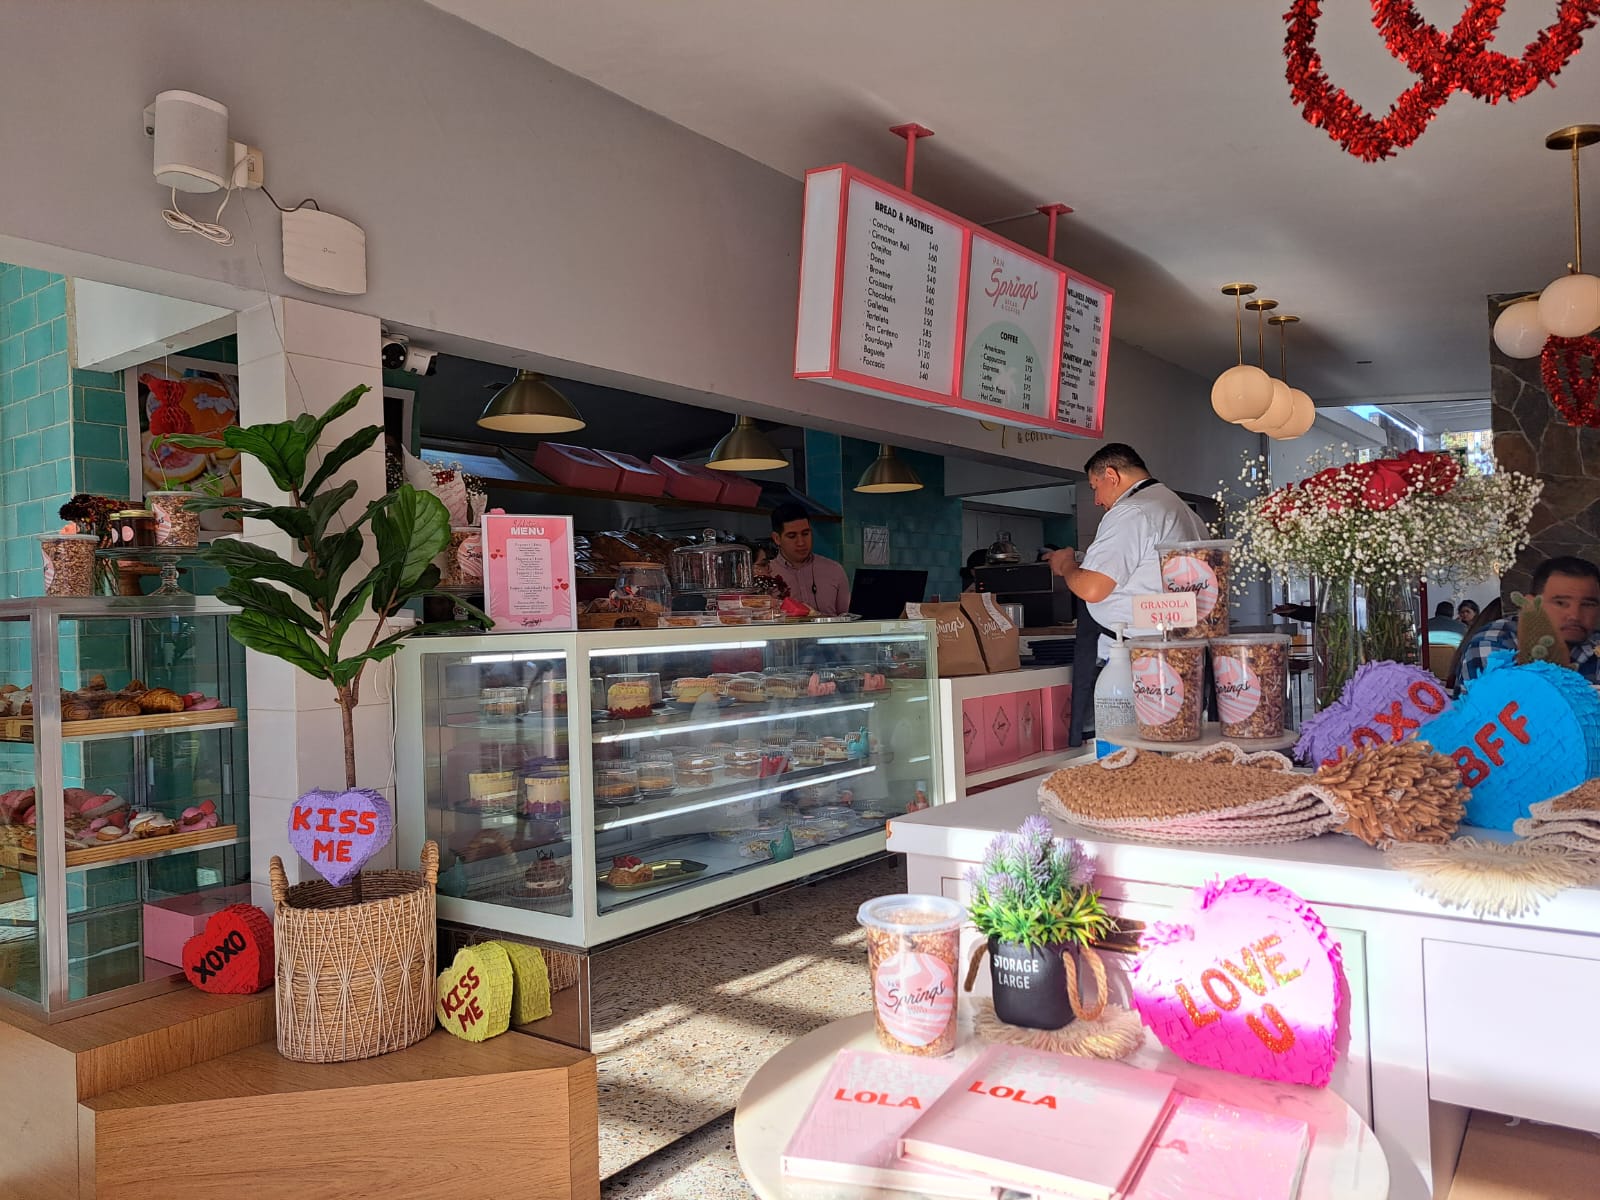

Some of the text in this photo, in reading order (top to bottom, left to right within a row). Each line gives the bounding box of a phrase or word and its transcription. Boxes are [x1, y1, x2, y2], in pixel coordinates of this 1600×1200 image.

[875, 201, 934, 235] BREAD & PASTRIES
[872, 218, 939, 252] Conchas $40
[872, 230, 898, 248] Cinnamon
[900, 240, 910, 252] Roll
[870, 241, 892, 256] Orejitas
[870, 252, 885, 265] Dona
[870, 264, 890, 278] Brownie
[868, 276, 894, 291] Croissant
[985, 267, 1039, 310] Springs
[867, 299, 888, 313] Galletas
[866, 310, 888, 324] Tartaleta
[866, 322, 876, 332] Pan
[864, 333, 893, 350] Sourdough
[1000, 331, 1018, 344] COFFEE
[984, 344, 1006, 356] Americano
[982, 374, 992, 382] Latte
[980, 392, 988, 400] Hot
[982, 382, 994, 392] French
[996, 386, 1006, 395] Press
[511, 527, 545, 536] MENU
[1140, 600, 1190, 610] GRANOLA
[1151, 612, 1181, 624] $140
[1133, 681, 1176, 701] Springs
[1452, 700, 1531, 789] BFF
[292, 805, 378, 836] KISS
[312, 838, 352, 863] ME
[192, 930, 247, 985] XOXO
[993, 954, 1040, 974] STORAGE
[998, 972, 1031, 990] LARGE
[1174, 934, 1302, 1028] LOVE
[440, 966, 480, 1020] KISS
[884, 980, 946, 1014] Springs
[458, 996, 484, 1033] ME
[1246, 1003, 1296, 1054] U
[834, 1088, 922, 1110] LOLA
[968, 1080, 1058, 1110] LOLA
